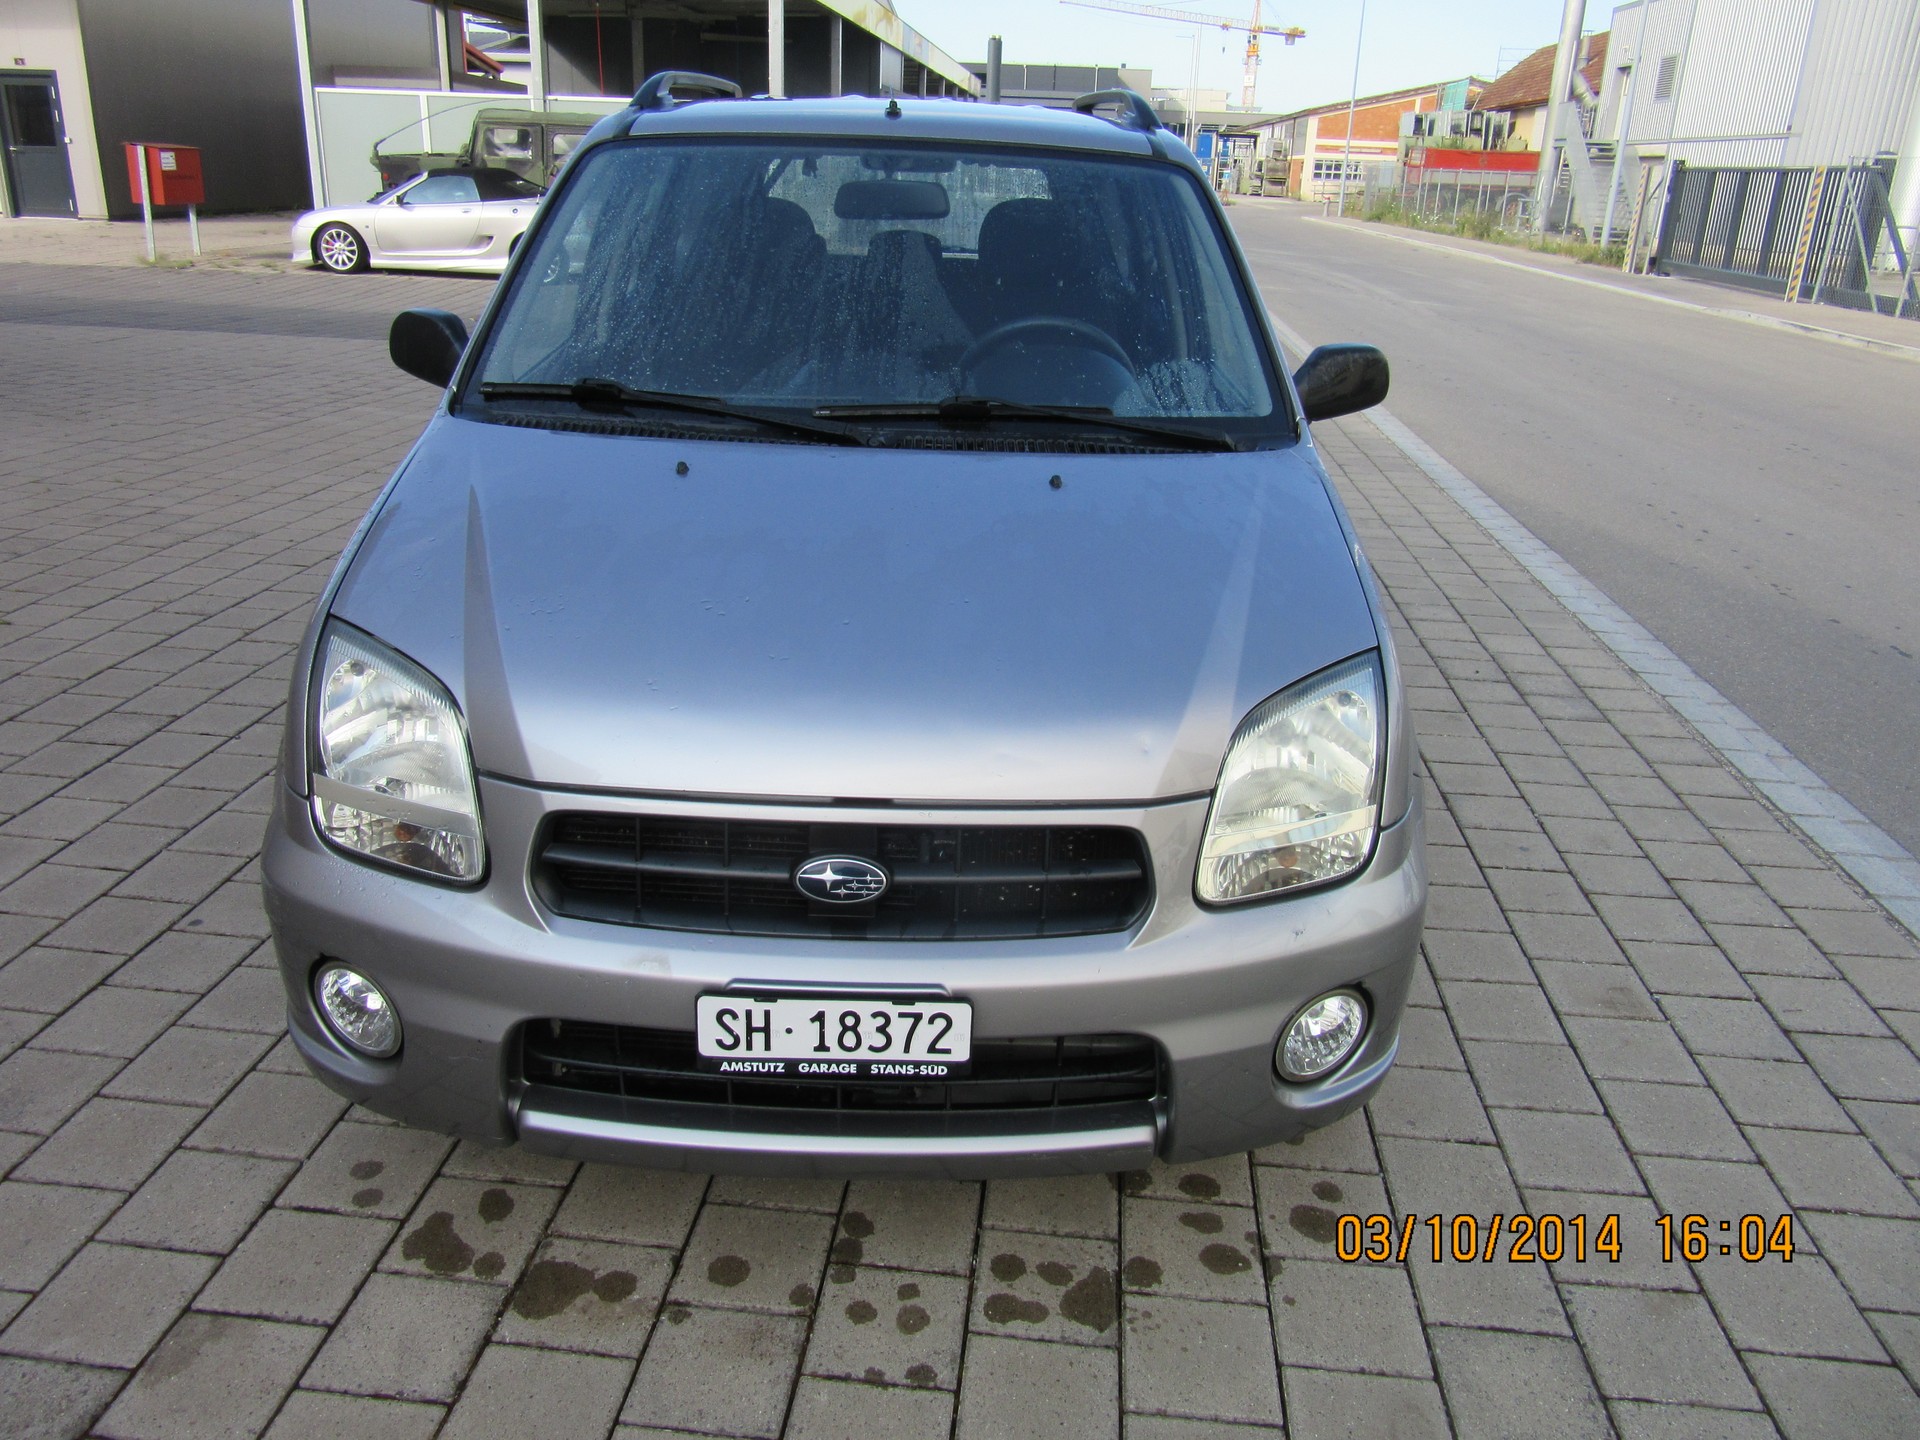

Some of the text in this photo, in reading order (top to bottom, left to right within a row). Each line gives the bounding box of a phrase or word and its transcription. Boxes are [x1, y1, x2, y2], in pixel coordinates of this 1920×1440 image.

[809, 1009, 954, 1055] 18372
[719, 1061, 948, 1076] AMSTUTZ GARAGE STANS-SÜD
